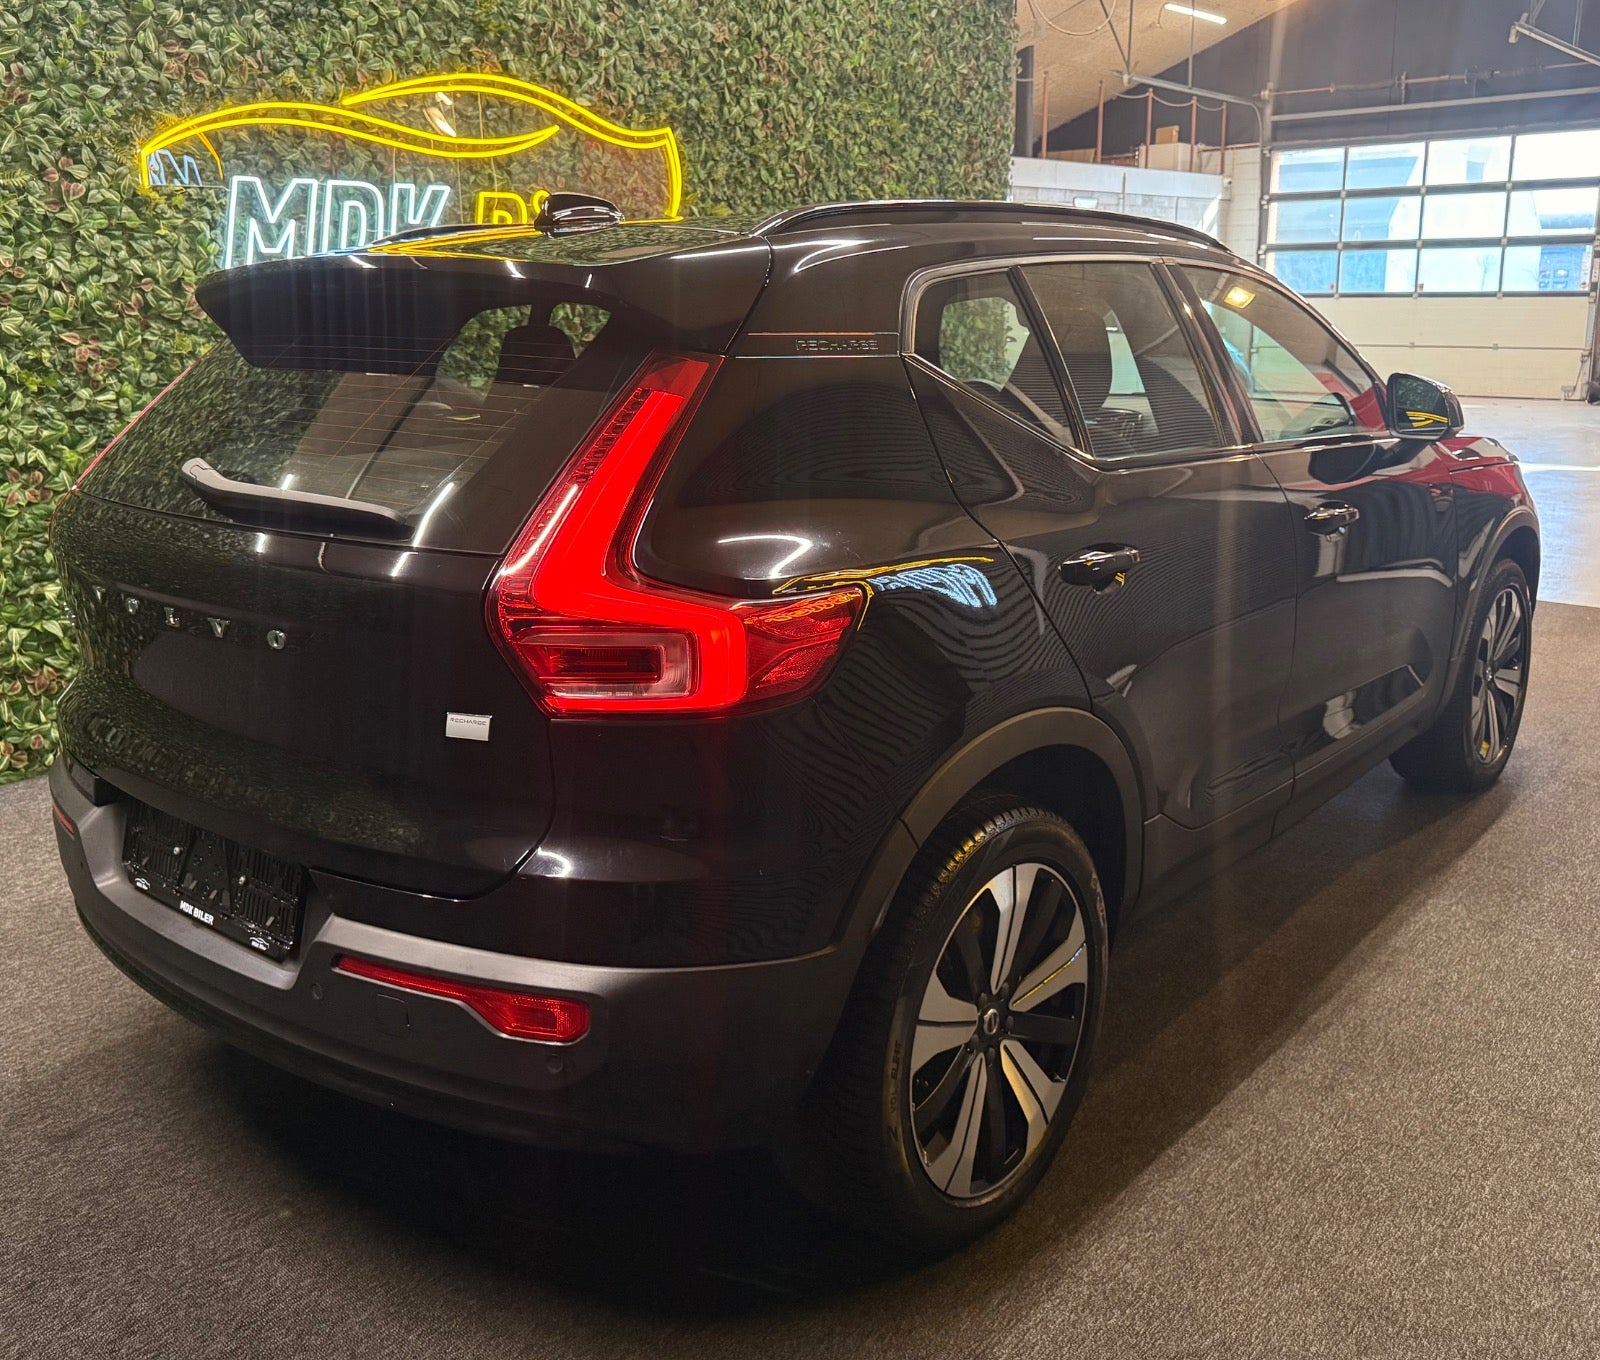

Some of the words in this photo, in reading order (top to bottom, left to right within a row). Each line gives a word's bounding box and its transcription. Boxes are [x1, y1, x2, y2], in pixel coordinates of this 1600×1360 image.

[224, 176, 451, 269] MDK
[796, 339, 880, 351] RECHARGE
[92, 585, 288, 650] VOLVO
[450, 717, 487, 726] RECHARGE
[180, 900, 194, 915] MDK
[193, 907, 214, 926] BILER
